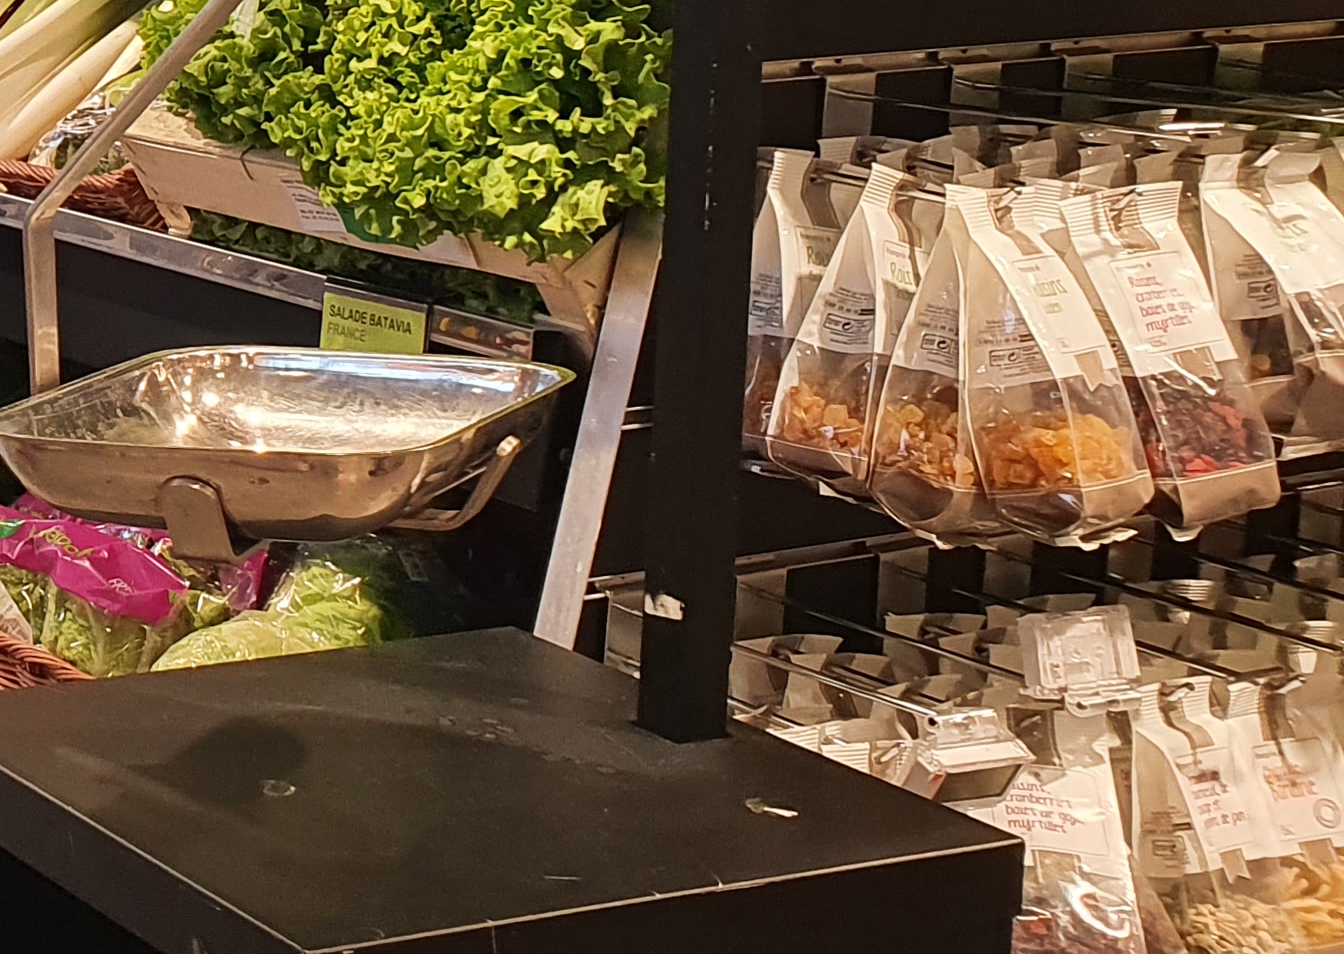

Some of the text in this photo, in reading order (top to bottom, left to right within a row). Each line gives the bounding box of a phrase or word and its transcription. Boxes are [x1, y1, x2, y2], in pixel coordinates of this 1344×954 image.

[327, 322, 366, 343] FRANCE
[329, 304, 412, 335] SALADE BATAVIA
